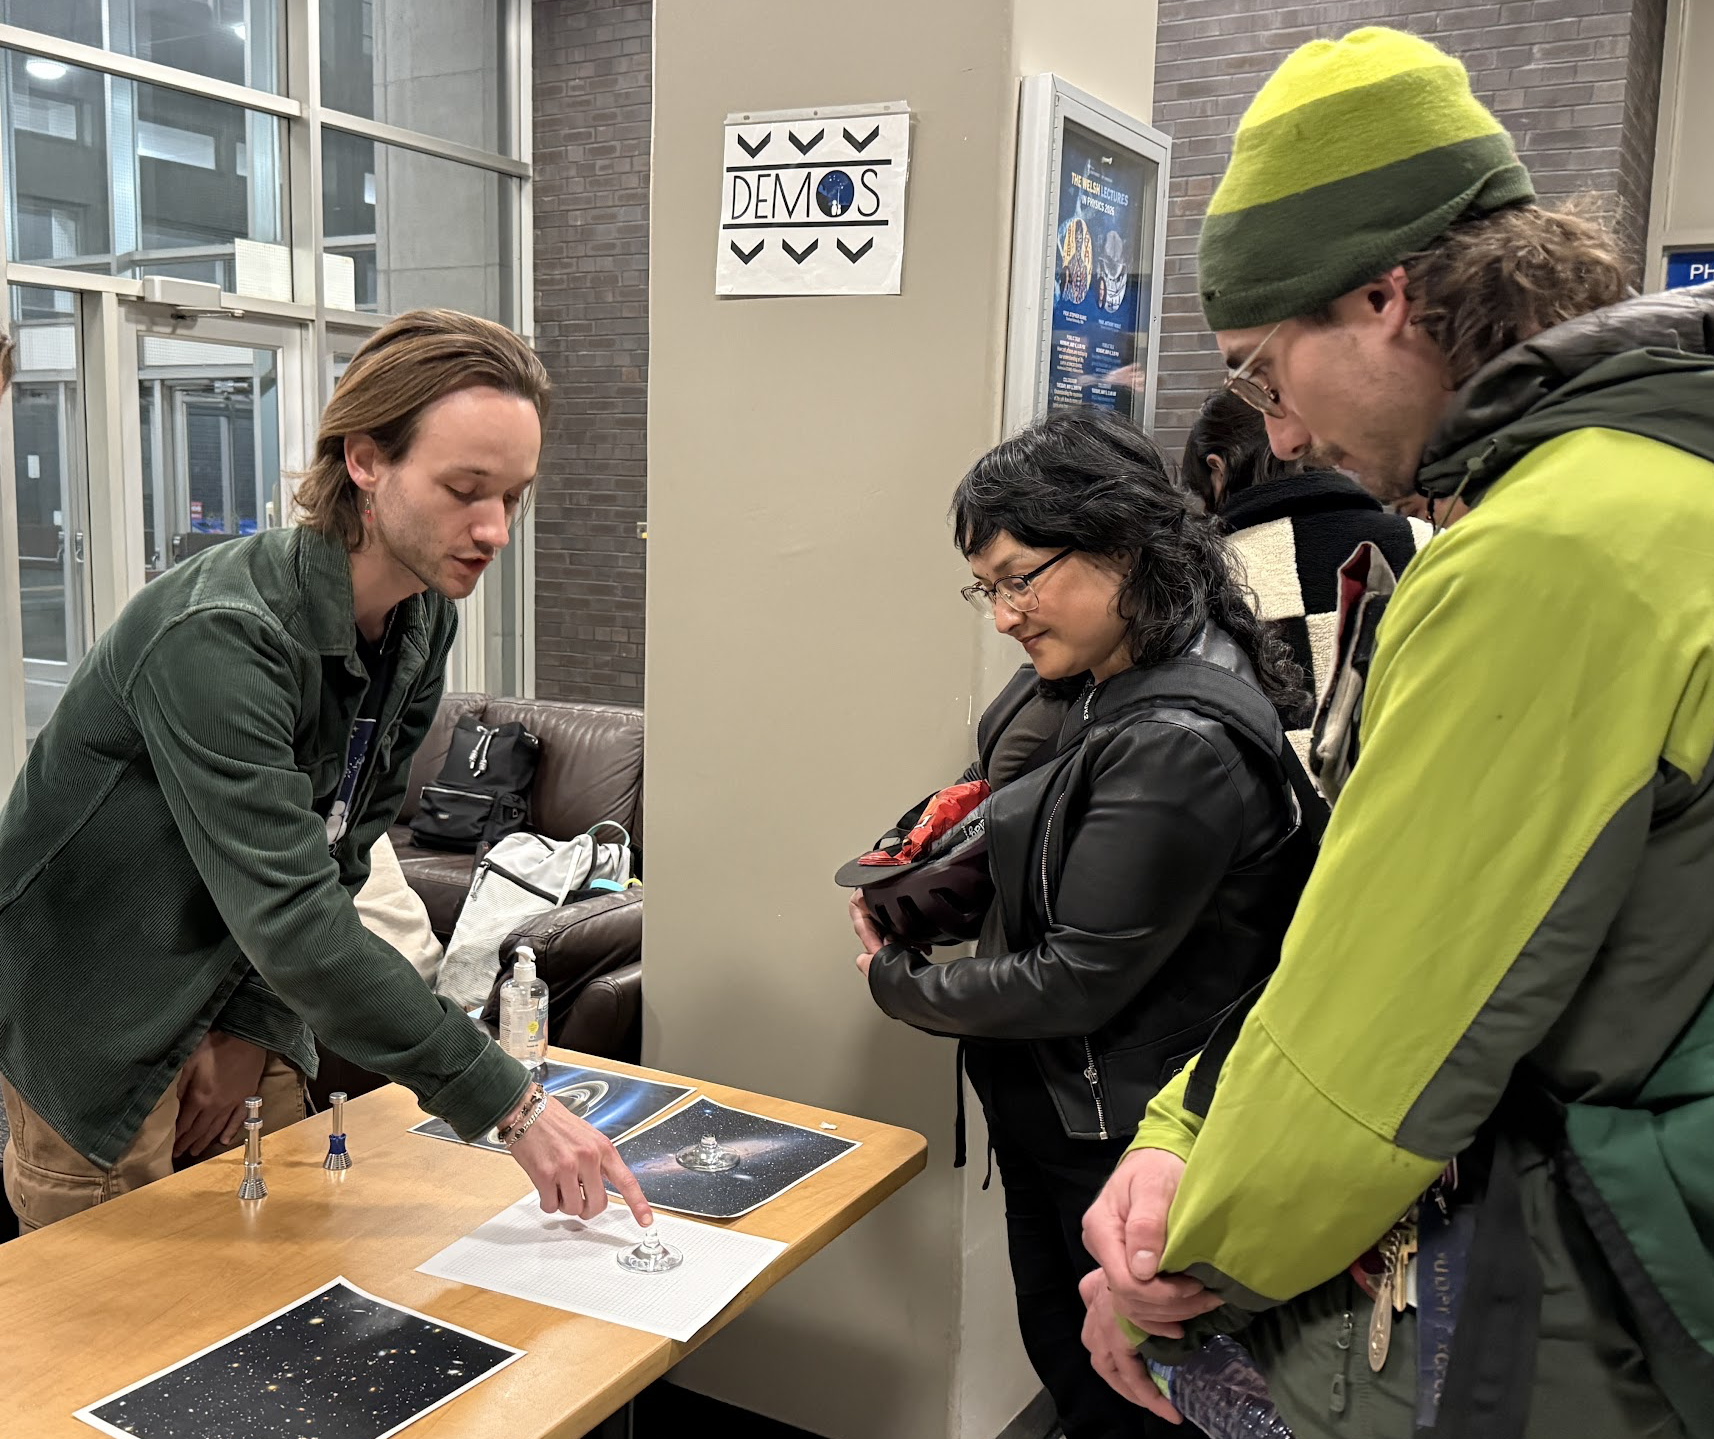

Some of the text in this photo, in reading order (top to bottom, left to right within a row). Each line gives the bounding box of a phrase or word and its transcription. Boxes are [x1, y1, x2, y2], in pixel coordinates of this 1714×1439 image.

[731, 168, 881, 220] DEMOS
[1071, 171, 1082, 188] THE
[1082, 176, 1101, 196] WELSH
[1100, 184, 1129, 207] LECTURES
